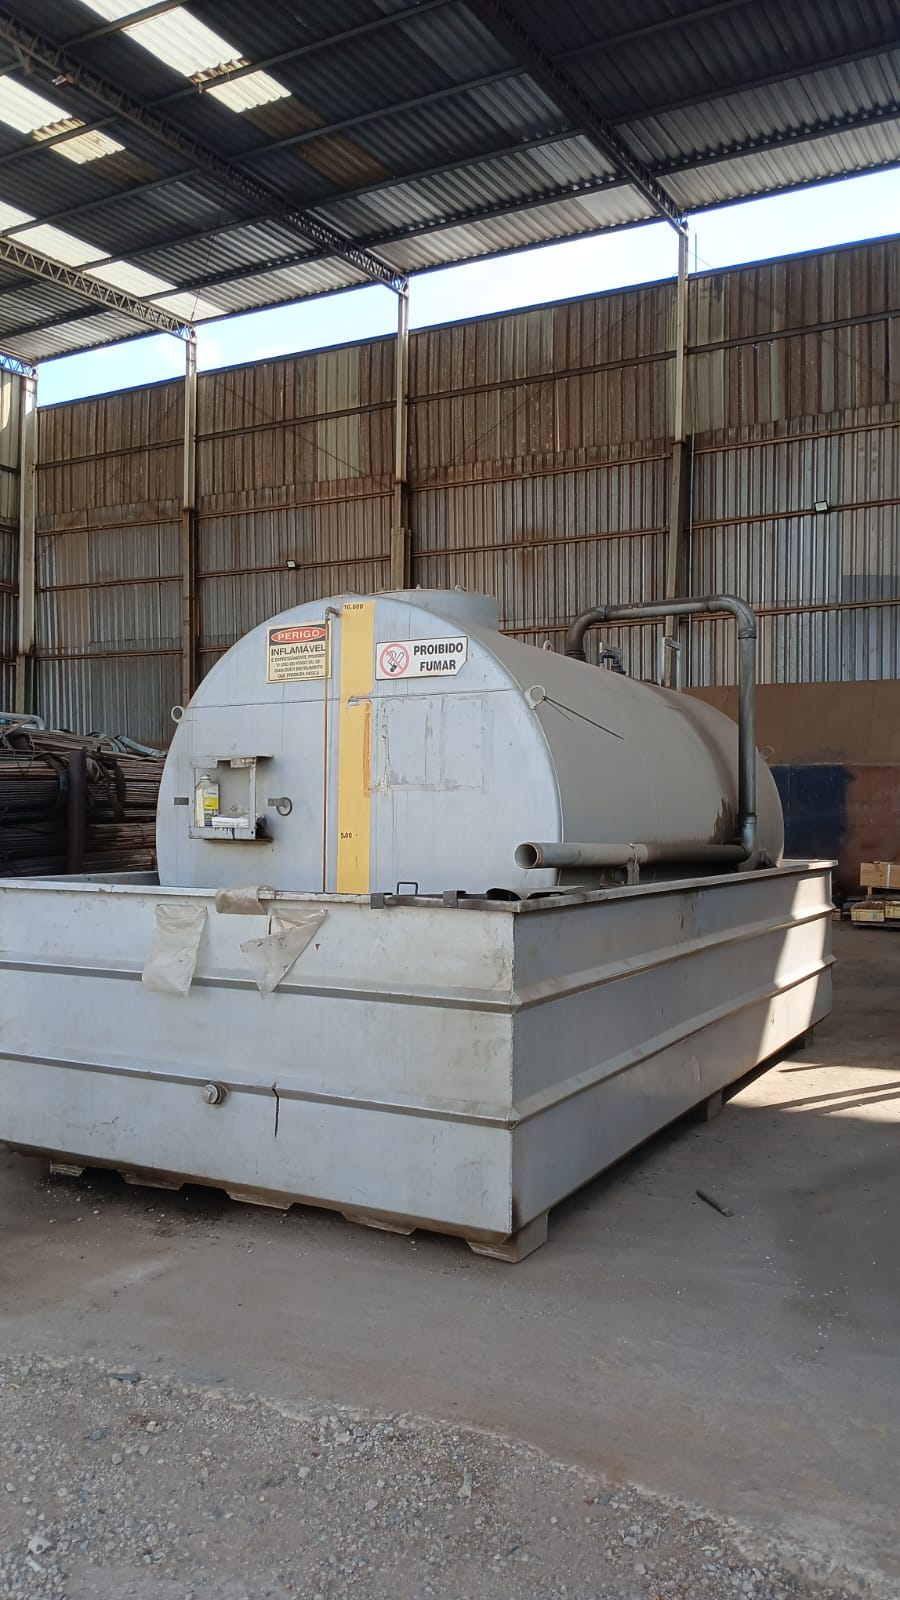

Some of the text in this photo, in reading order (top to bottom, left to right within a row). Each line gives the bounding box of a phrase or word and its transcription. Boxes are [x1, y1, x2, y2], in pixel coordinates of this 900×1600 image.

[277, 629, 320, 641] PERIGO
[271, 644, 326, 656] INFLAMÁVEL
[413, 642, 464, 656] PROIBIDO
[419, 659, 456, 672] FUMAR
